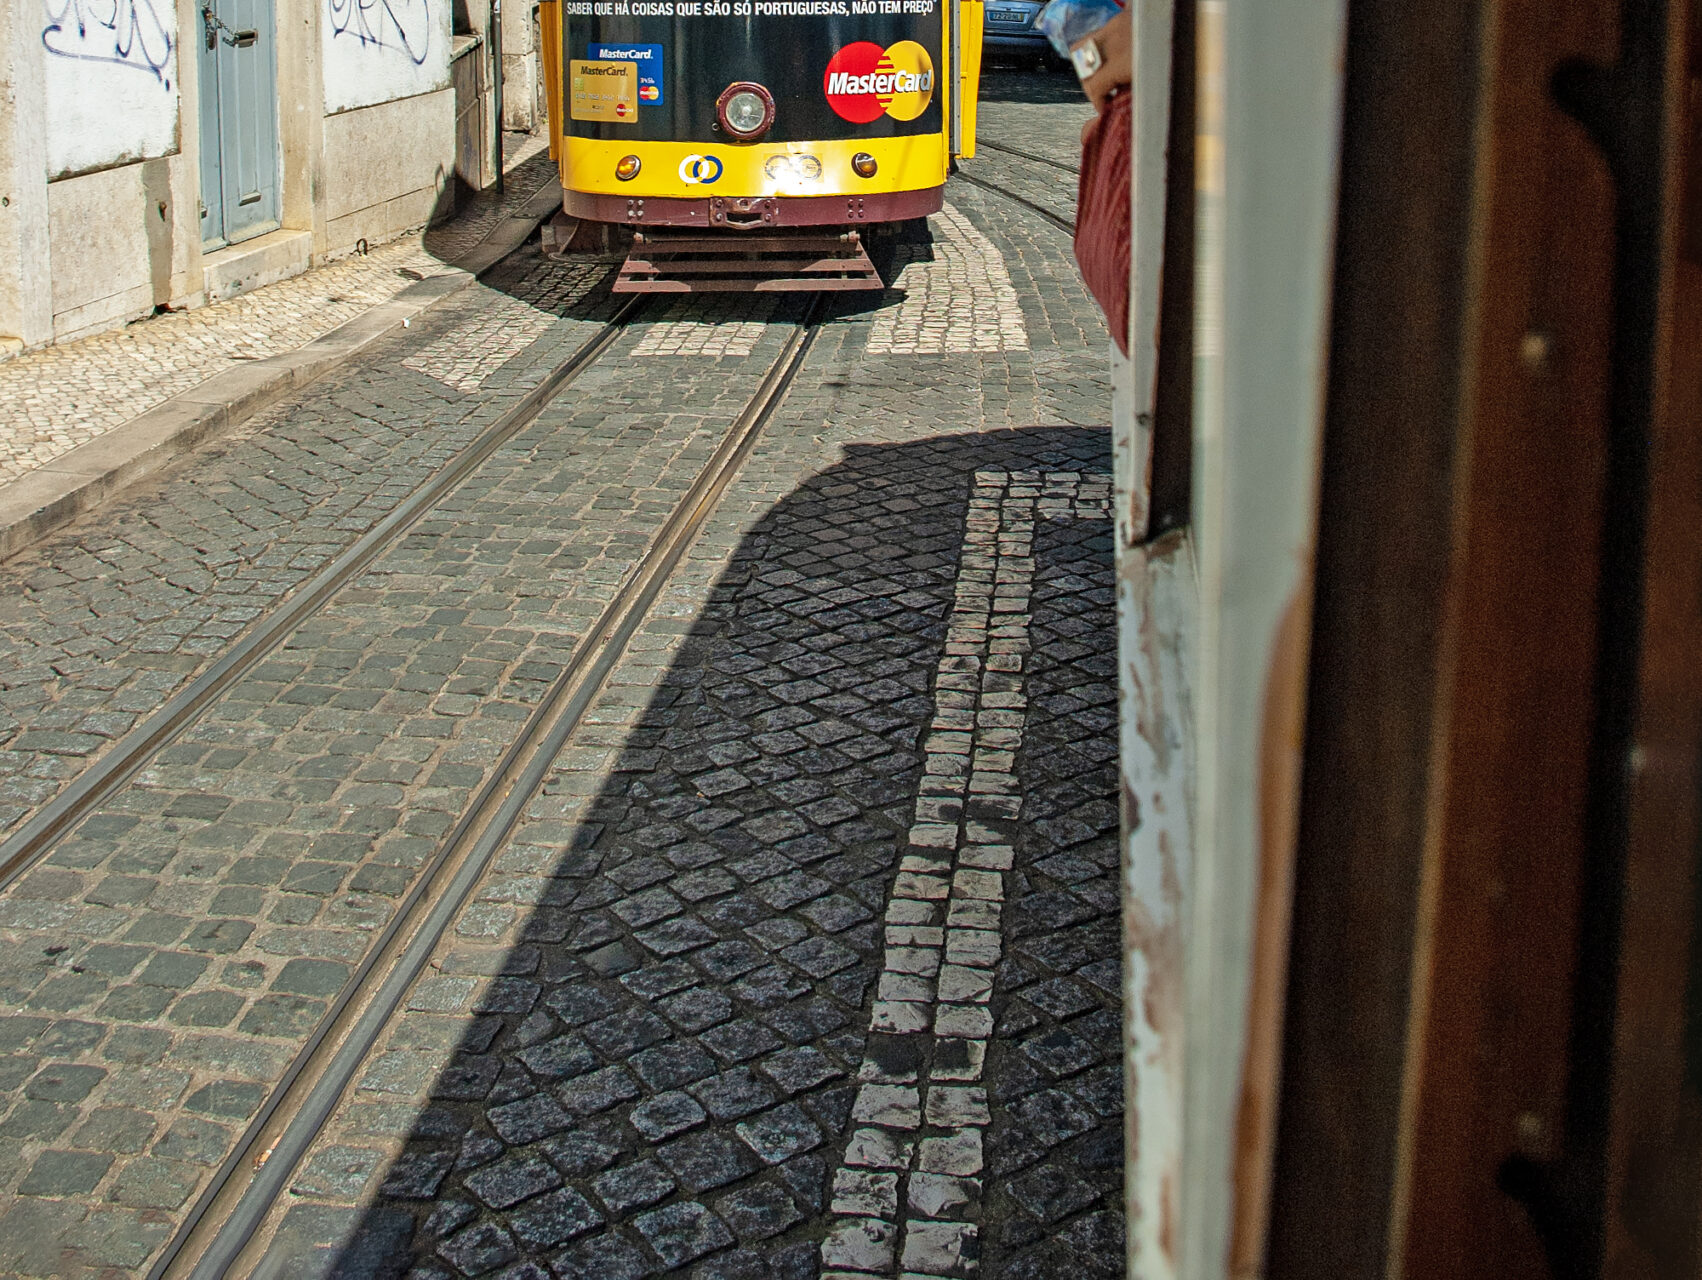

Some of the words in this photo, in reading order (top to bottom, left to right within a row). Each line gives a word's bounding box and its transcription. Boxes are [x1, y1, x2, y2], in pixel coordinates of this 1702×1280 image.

[567, 1, 593, 15] SABER
[594, 2, 613, 16] QUE
[615, 0, 628, 15] HÁ
[631, 2, 674, 16] COISAS
[676, 2, 701, 17] QUE
[703, 0, 731, 16] SÃO
[733, 0, 752, 16] SÓ
[754, 1, 850, 17] PORTUGUESAS,
[878, 0, 901, 14] TEM
[827, 69, 932, 95] MasterCard
